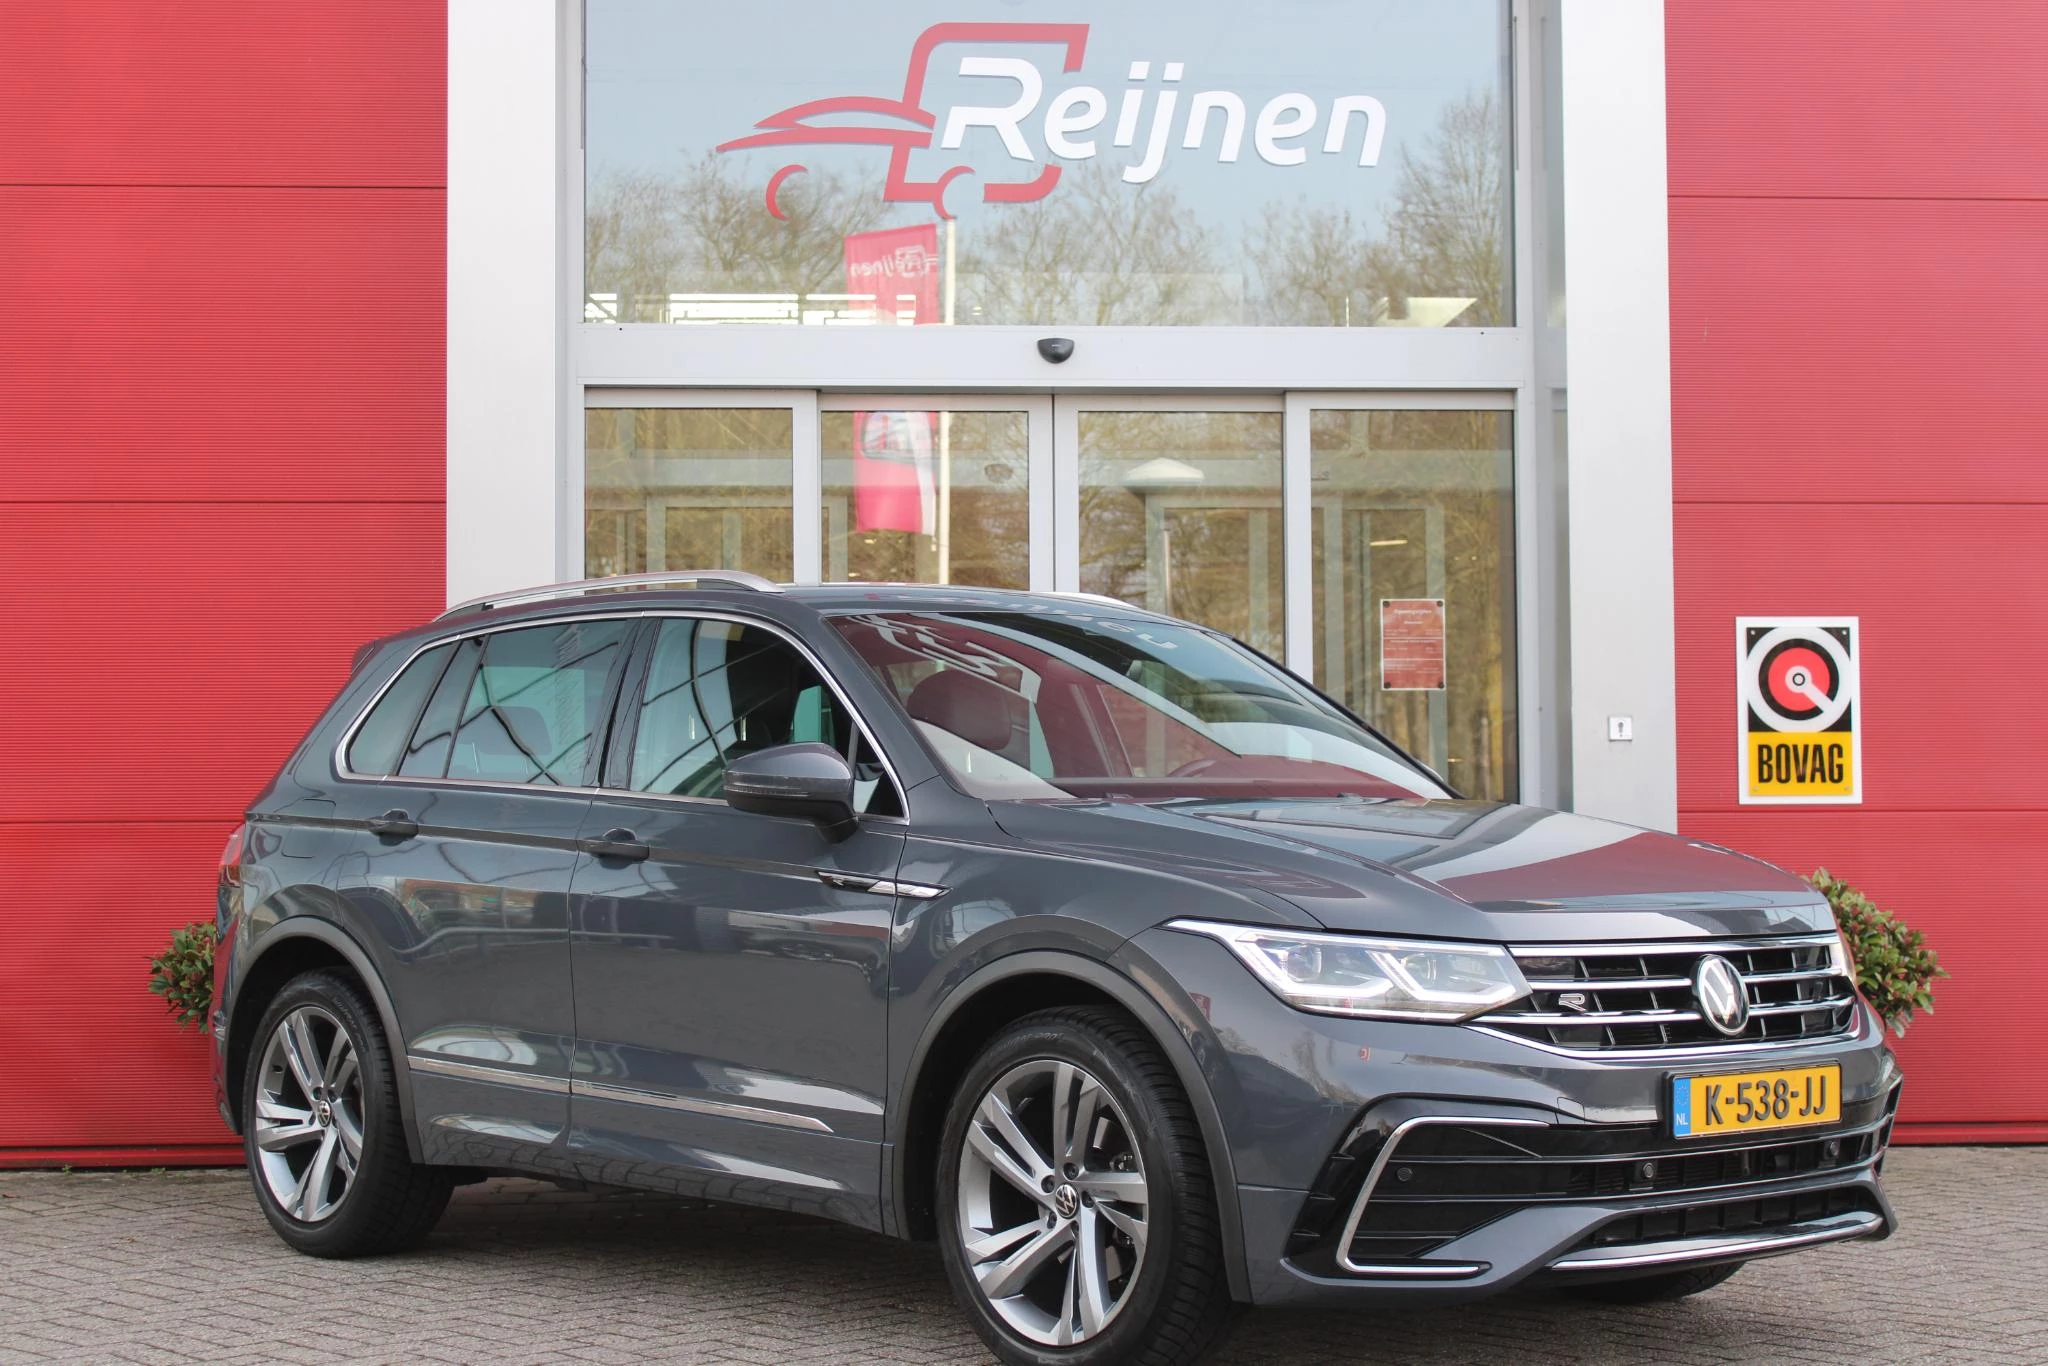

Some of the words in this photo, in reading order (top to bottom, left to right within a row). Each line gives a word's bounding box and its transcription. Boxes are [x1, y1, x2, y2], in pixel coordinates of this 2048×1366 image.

[941, 57, 1387, 184] Reijnen
[1757, 743, 1844, 784] BOVAG
[1558, 993, 1586, 1011] R
[1676, 1113, 1688, 1126] NL
[1705, 1075, 1827, 1126] K-538-JJ
